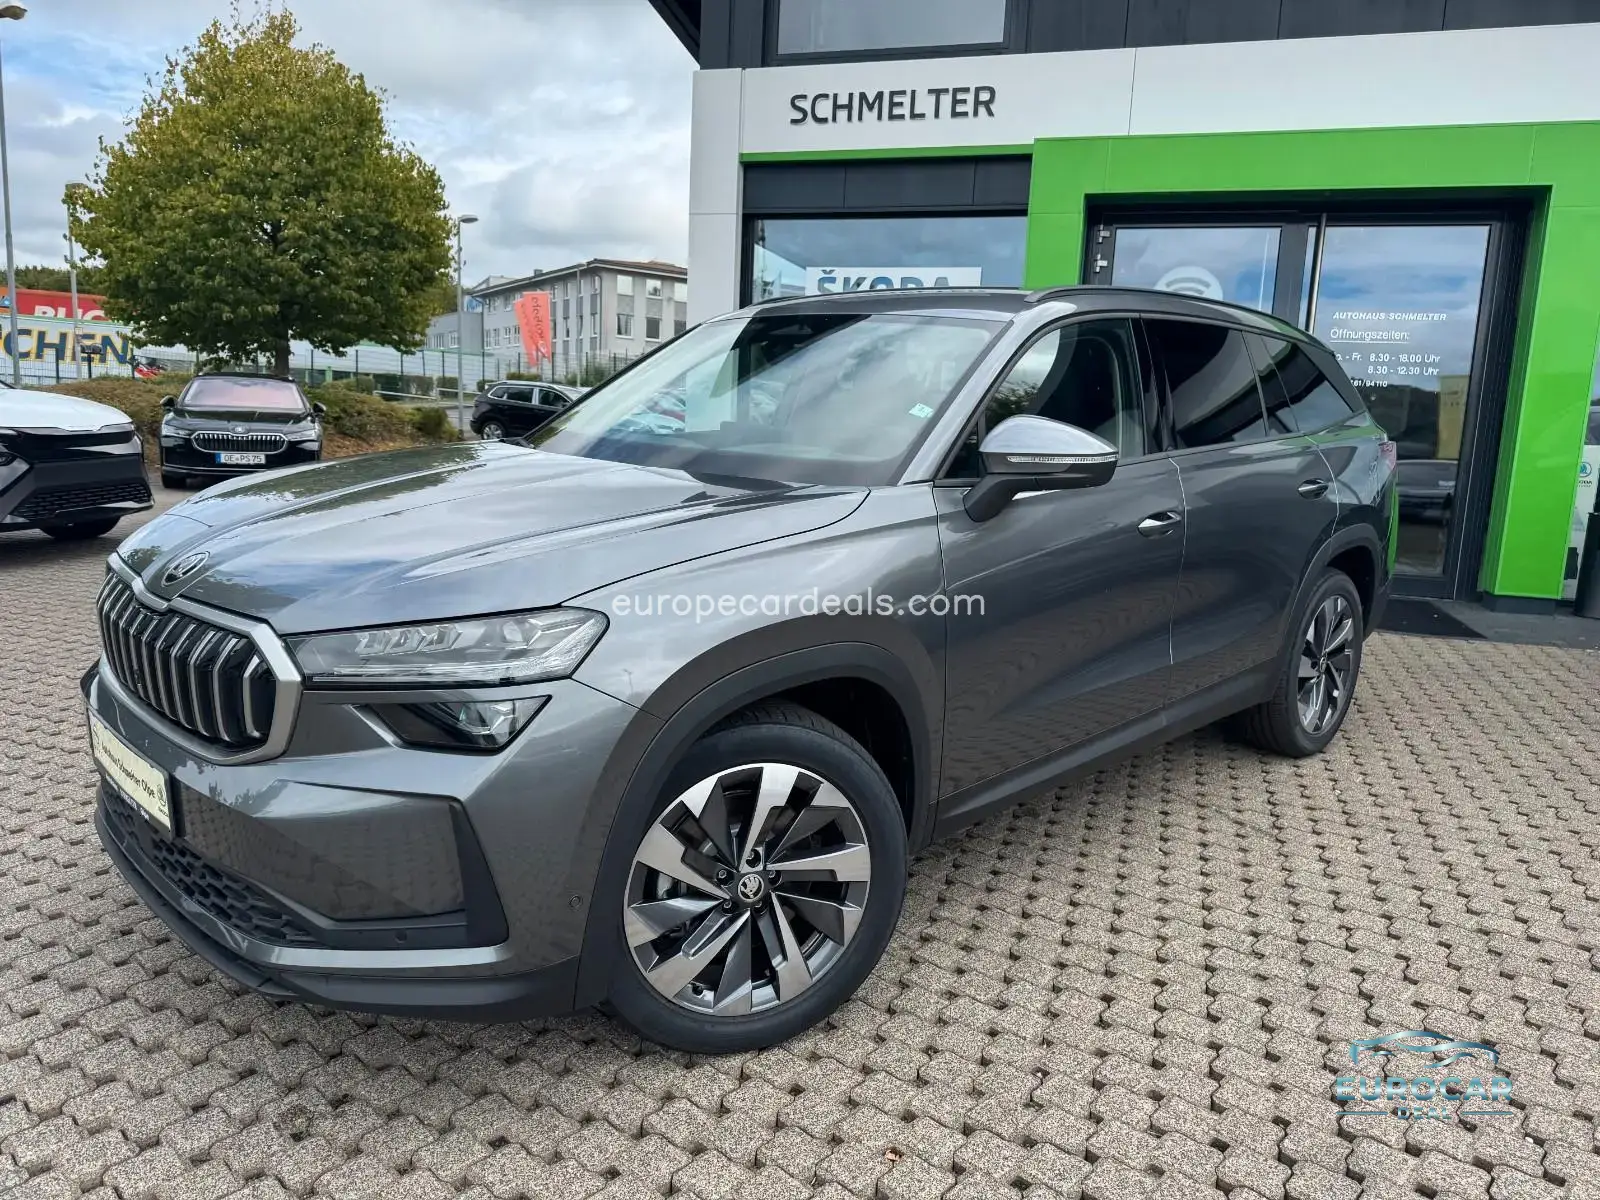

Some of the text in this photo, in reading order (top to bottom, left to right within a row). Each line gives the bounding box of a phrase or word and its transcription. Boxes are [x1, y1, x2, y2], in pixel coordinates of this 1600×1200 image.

[790, 86, 996, 126] SCHMELTER
[1333, 311, 1447, 321] AUTOHAUS SCHMELTER
[1330, 327, 1410, 341] Öffnungszeiten:
[0, 328, 130, 364] CHEN
[1351, 352, 1363, 361] Fr.
[1369, 353, 1390, 362] 8.30
[1399, 354, 1422, 363] 18.00
[1424, 354, 1441, 363] Uhr
[1367, 366, 1388, 374] 8.30
[1397, 366, 1420, 375] 12.30
[1423, 367, 1439, 376] Uhr
